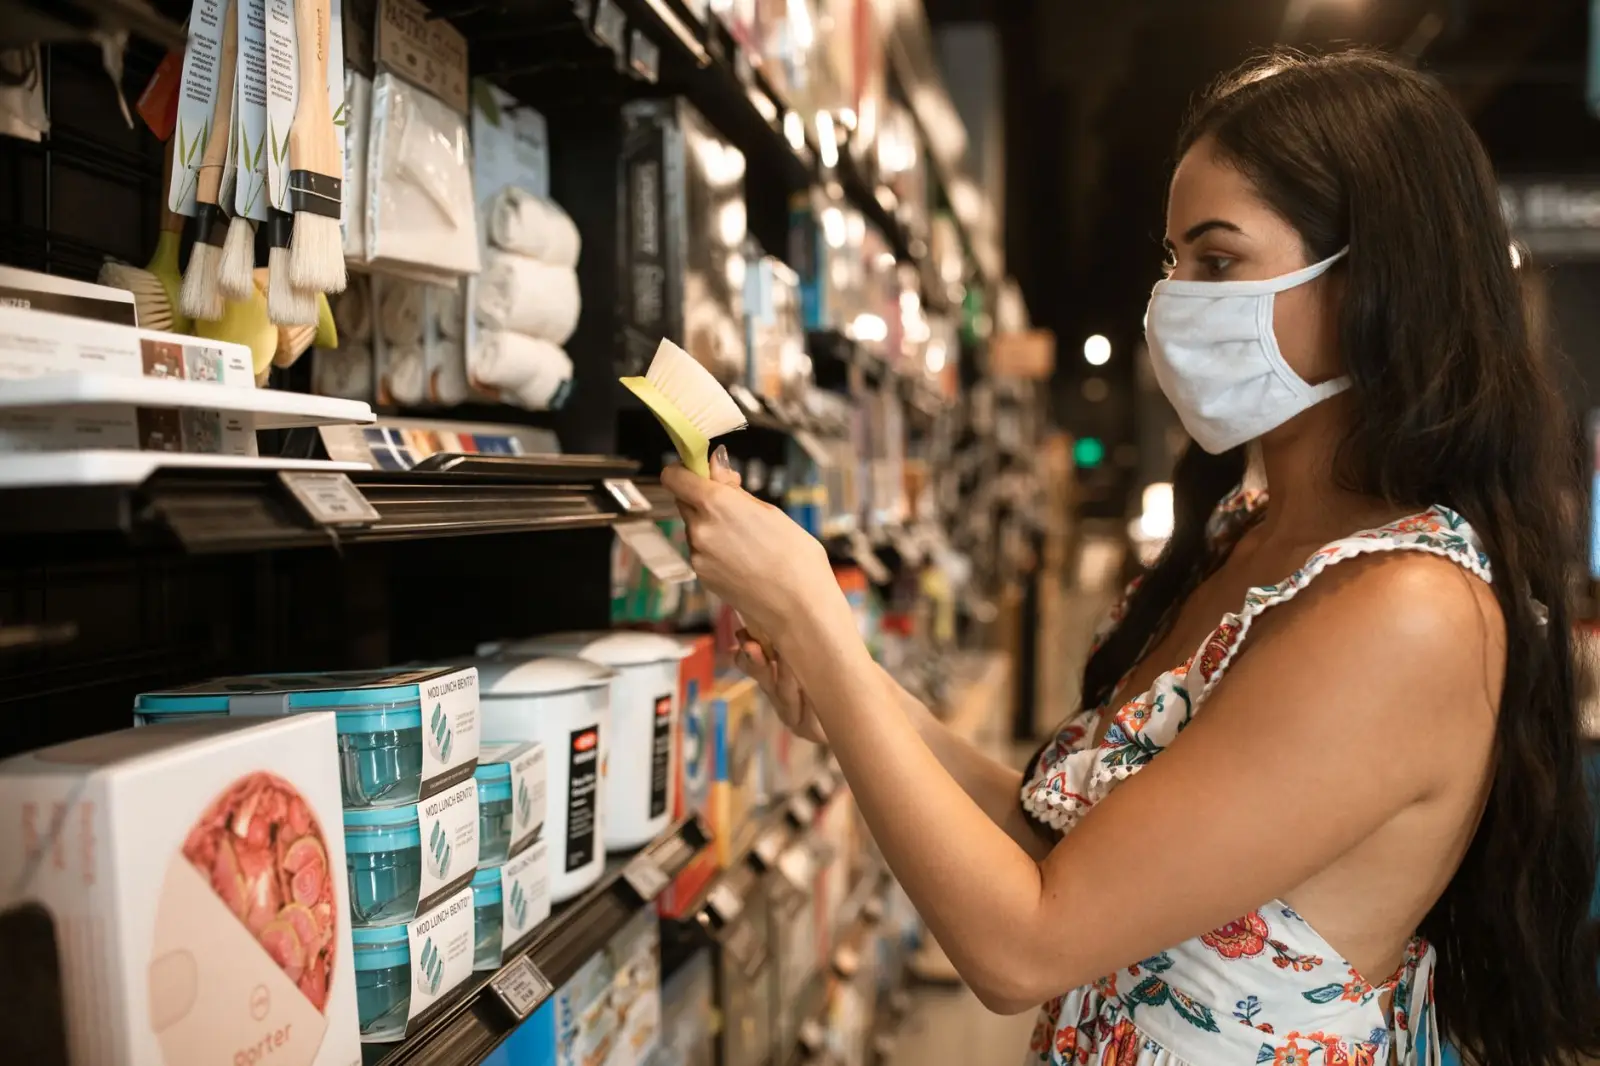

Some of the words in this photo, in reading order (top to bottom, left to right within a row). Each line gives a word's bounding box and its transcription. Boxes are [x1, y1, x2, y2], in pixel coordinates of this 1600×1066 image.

[427, 686, 440, 699] MOD
[440, 679, 457, 696] LUNCH
[425, 803, 438, 818] MOD
[438, 793, 456, 812] LUNCH
[416, 920, 430, 937] MOD
[430, 908, 449, 928] LUNCH
